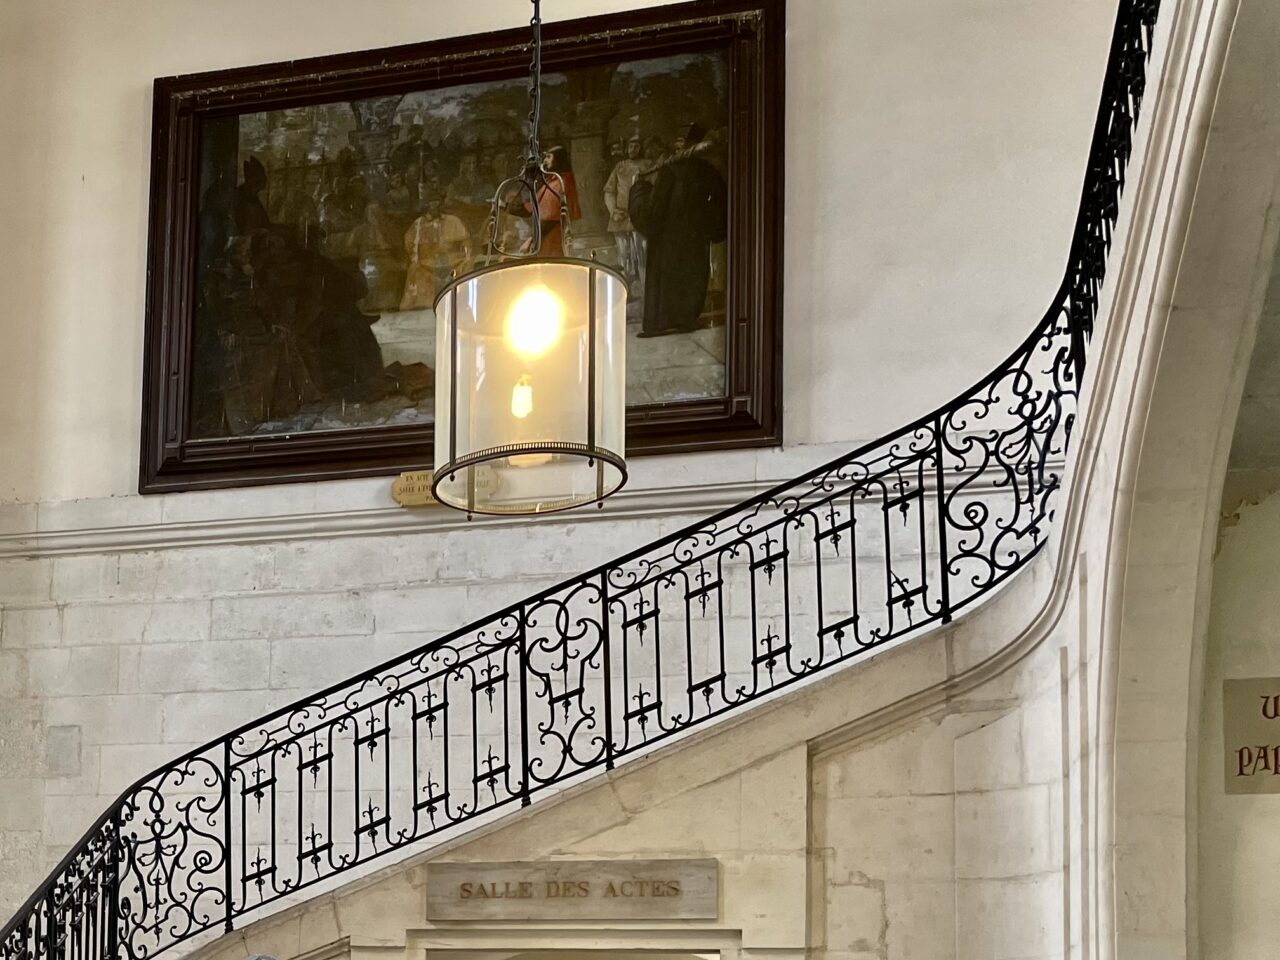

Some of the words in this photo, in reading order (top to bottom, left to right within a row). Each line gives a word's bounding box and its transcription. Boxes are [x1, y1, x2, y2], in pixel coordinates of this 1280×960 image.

[459, 881, 533, 899] SALLE
[545, 880, 591, 898] DES
[603, 879, 682, 898] ACTES
